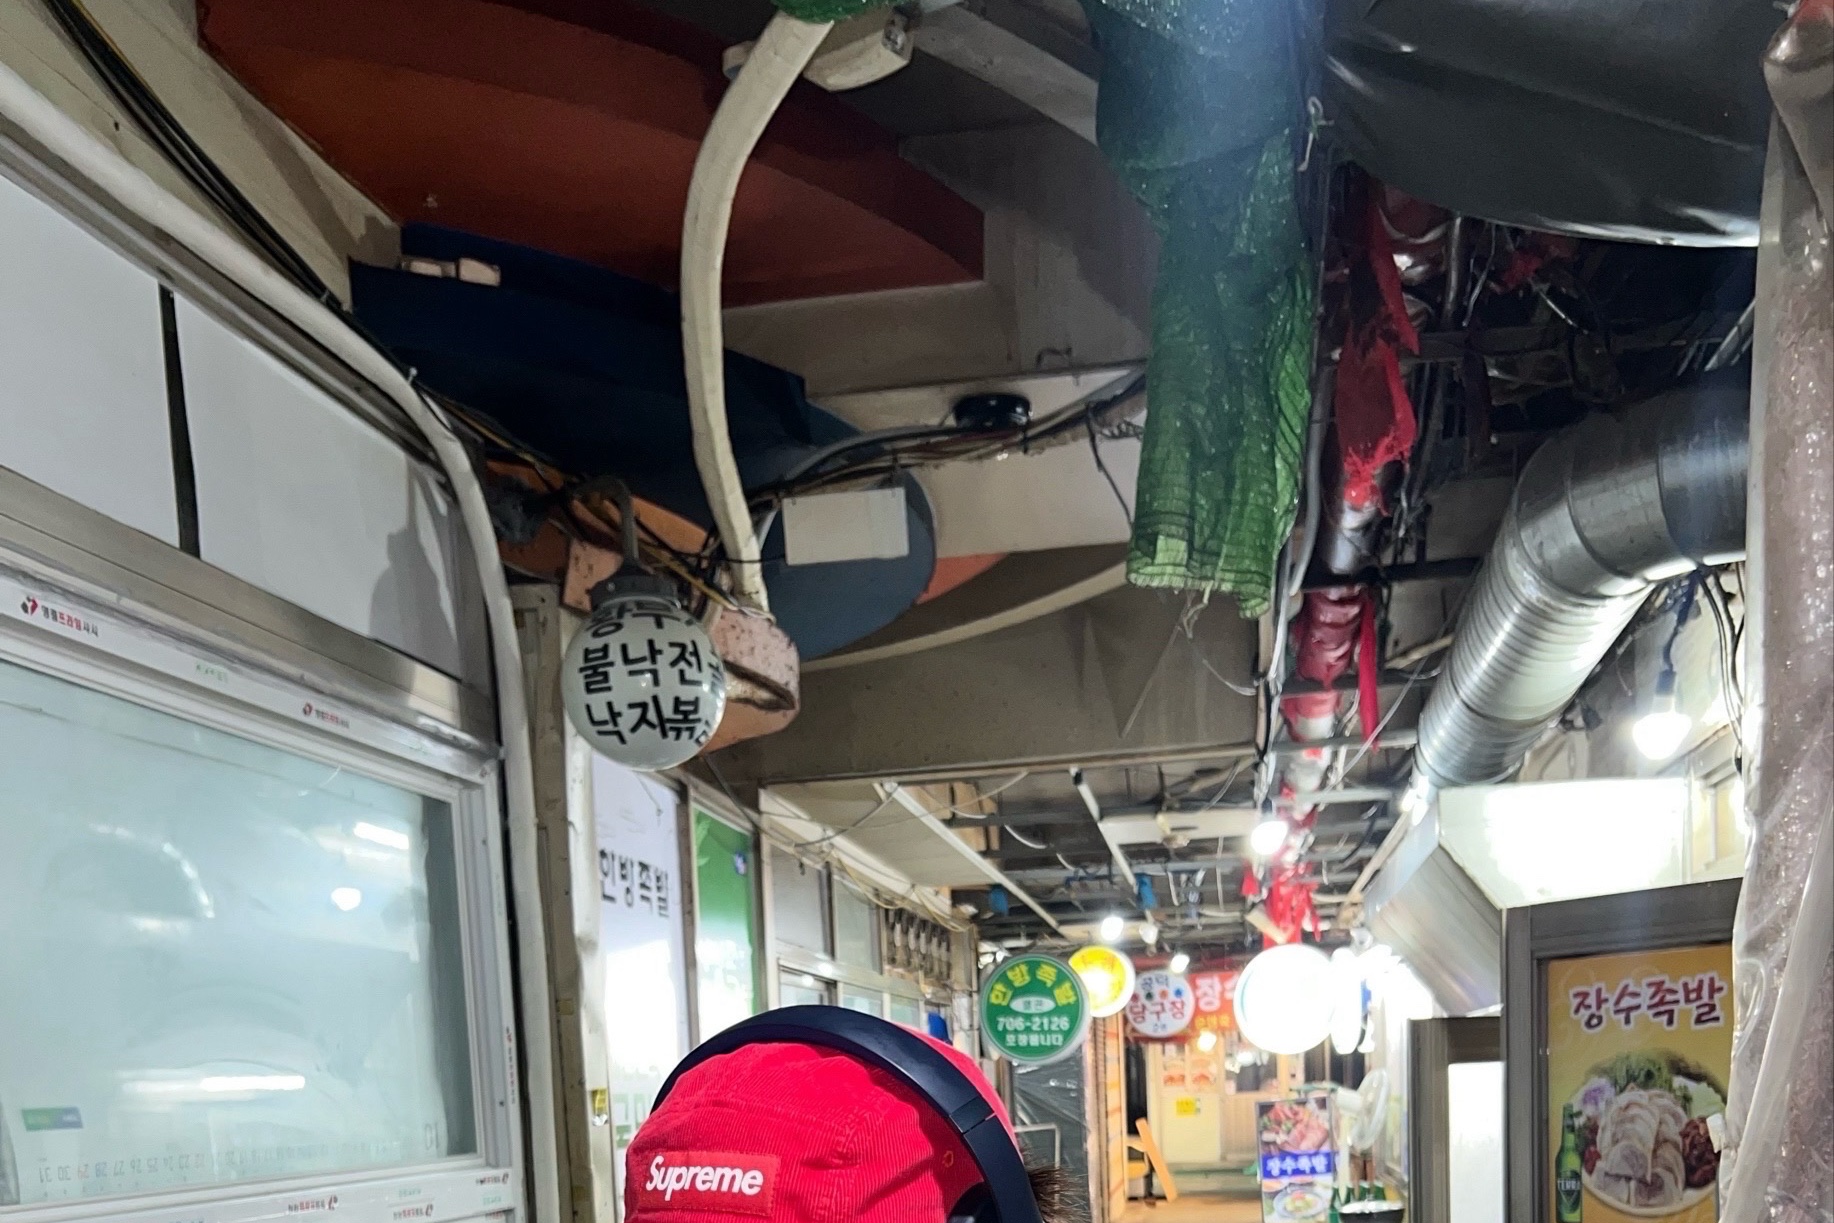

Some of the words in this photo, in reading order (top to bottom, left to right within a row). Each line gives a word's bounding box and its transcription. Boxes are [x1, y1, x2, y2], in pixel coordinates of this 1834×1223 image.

[996, 1016, 1071, 1032] 706-2126
[1571, 974, 1726, 1030] 장수족발
[645, 1154, 764, 1201] Supreme
